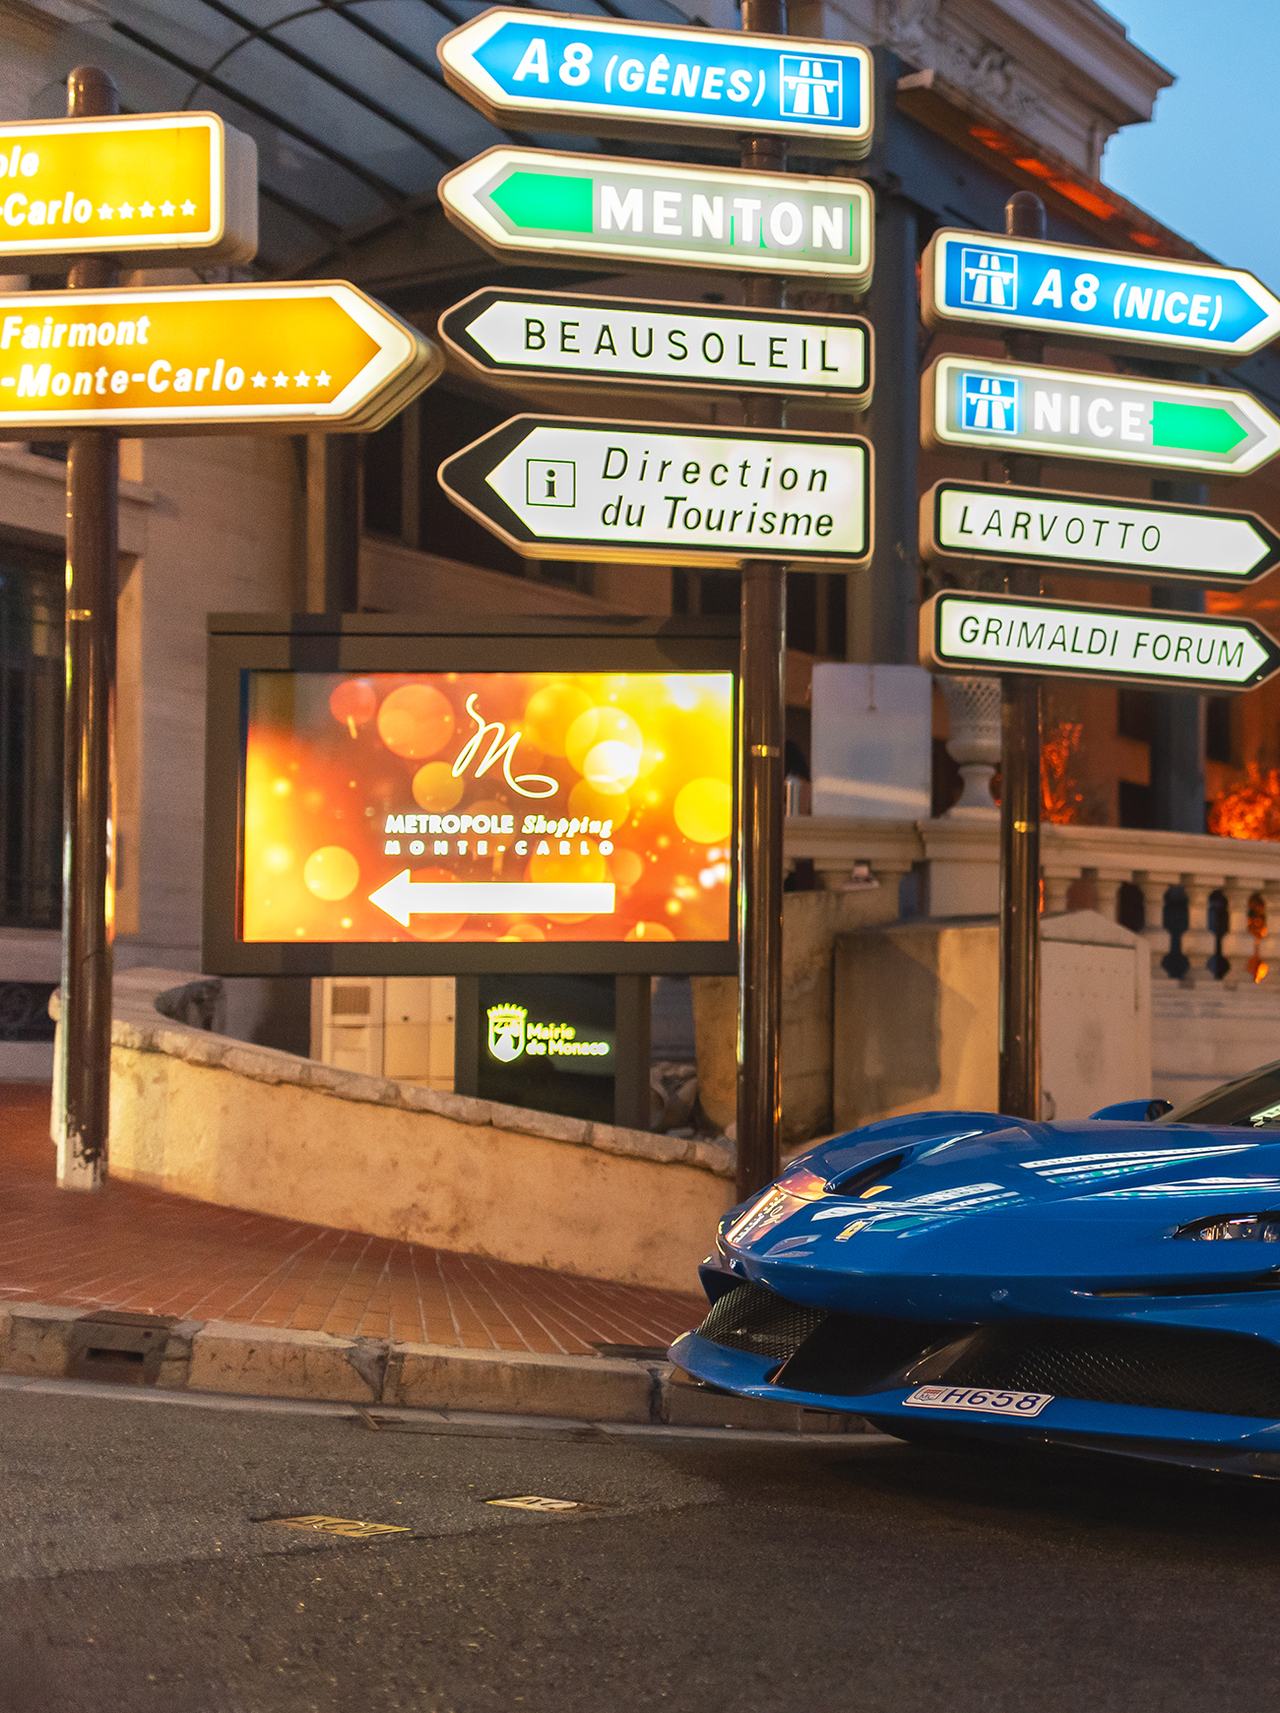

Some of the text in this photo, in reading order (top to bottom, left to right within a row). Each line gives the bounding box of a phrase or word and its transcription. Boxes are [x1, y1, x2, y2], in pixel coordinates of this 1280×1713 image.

[604, 53, 767, 107] (GÊNES)
[0, 190, 93, 227] Carlo
[601, 185, 844, 250] MENTON
[1113, 282, 1223, 331] (NICE)
[0, 315, 150, 350] Fairmont
[524, 317, 840, 373] BEAUSOLEIL
[0, 358, 245, 397] -Monte-Carlo
[1034, 390, 1146, 442] NICE
[601, 446, 829, 492] Direction
[601, 495, 834, 538] du Tourisme
[958, 506, 1162, 552] LARVOTTO
[960, 616, 1245, 668] GRIMALDI FORUM
[385, 814, 614, 839] METROPOLE Shopping
[385, 840, 615, 856] MONTE-CARLO
[525, 1038, 610, 1056] de Monaco
[526, 1022, 577, 1041] Mairie
[941, 1388, 1042, 1411] H658
